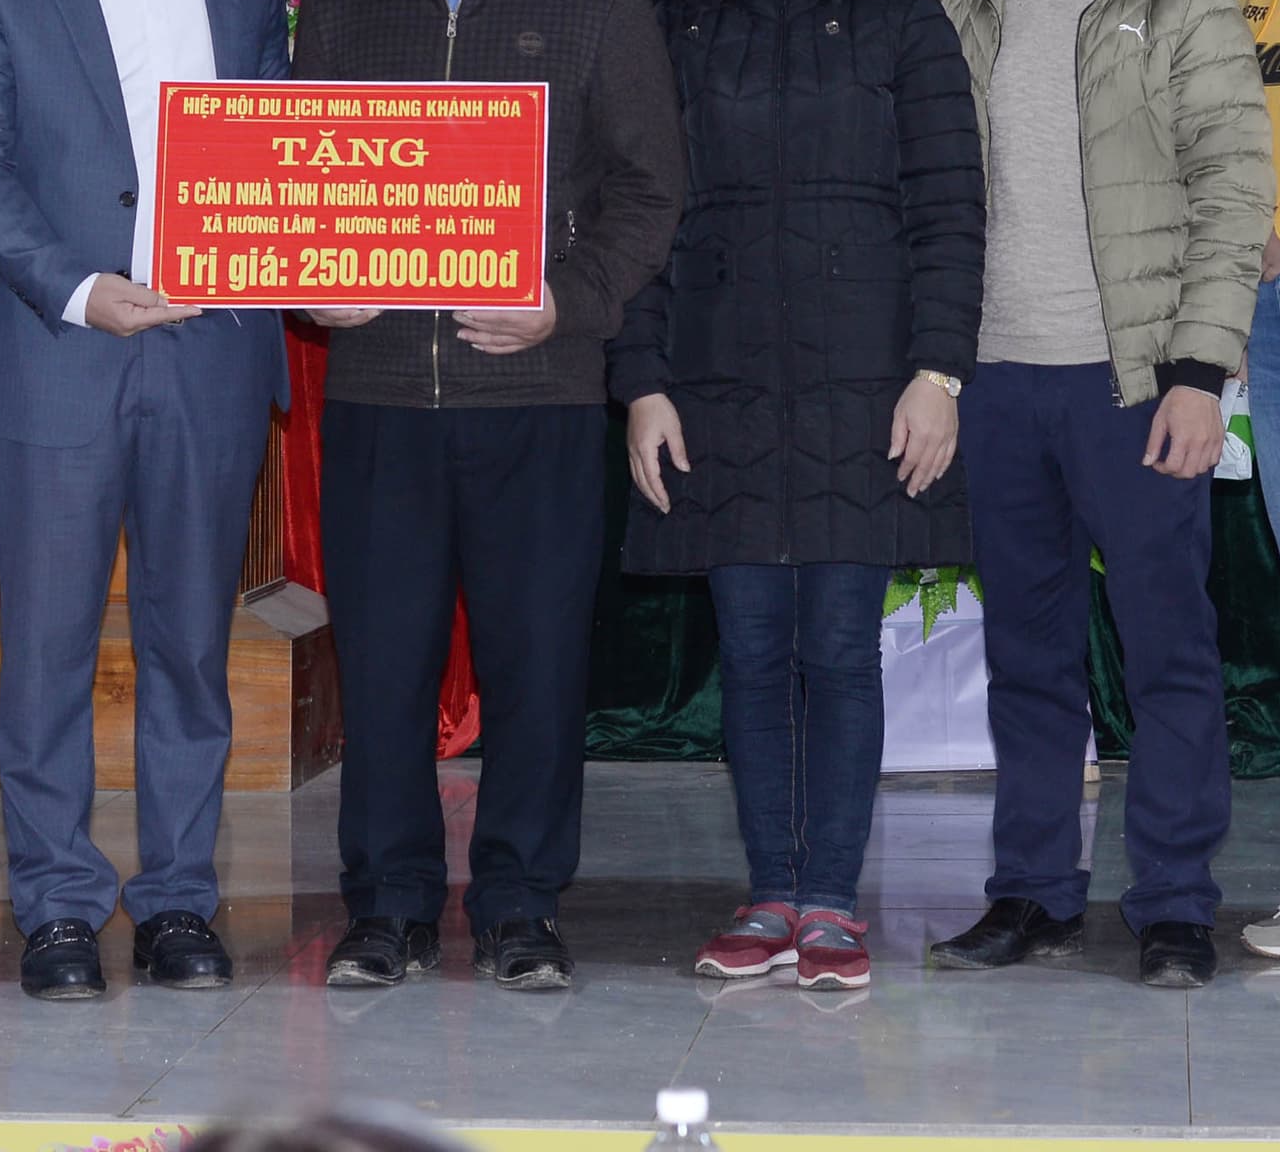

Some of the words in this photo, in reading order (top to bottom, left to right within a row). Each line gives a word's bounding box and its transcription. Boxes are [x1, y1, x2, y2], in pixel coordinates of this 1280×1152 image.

[183, 94, 221, 119] HIỆP
[226, 94, 254, 119] HỘI
[259, 98, 281, 116] DU
[286, 99, 322, 120] LỊCH
[327, 99, 362, 117] NHA
[368, 99, 421, 117] TRANG
[426, 96, 483, 118] KHÁNH
[488, 96, 521, 118] HÒA
[272, 129, 429, 174] TẶNG
[178, 181, 189, 205] 5
[194, 177, 231, 205] CĂN
[236, 178, 272, 206] NHÀ
[278, 178, 318, 206] TÌNH
[323, 179, 378, 207] NGHĨA
[383, 183, 419, 207] CHO
[424, 178, 478, 207] NGƯỜI
[484, 179, 521, 208] DÂN
[202, 213, 223, 233] XÃ
[227, 216, 279, 234] HƯƠNG
[283, 213, 316, 234] LÂM
[335, 216, 387, 234] HƯƠNG
[391, 214, 421, 234] KHÊ
[435, 215, 456, 235] HÀ
[461, 215, 495, 235] TĨNH
[176, 246, 218, 295] Trị
[228, 246, 288, 292] giá:
[298, 248, 520, 288] 250.000.000đ
